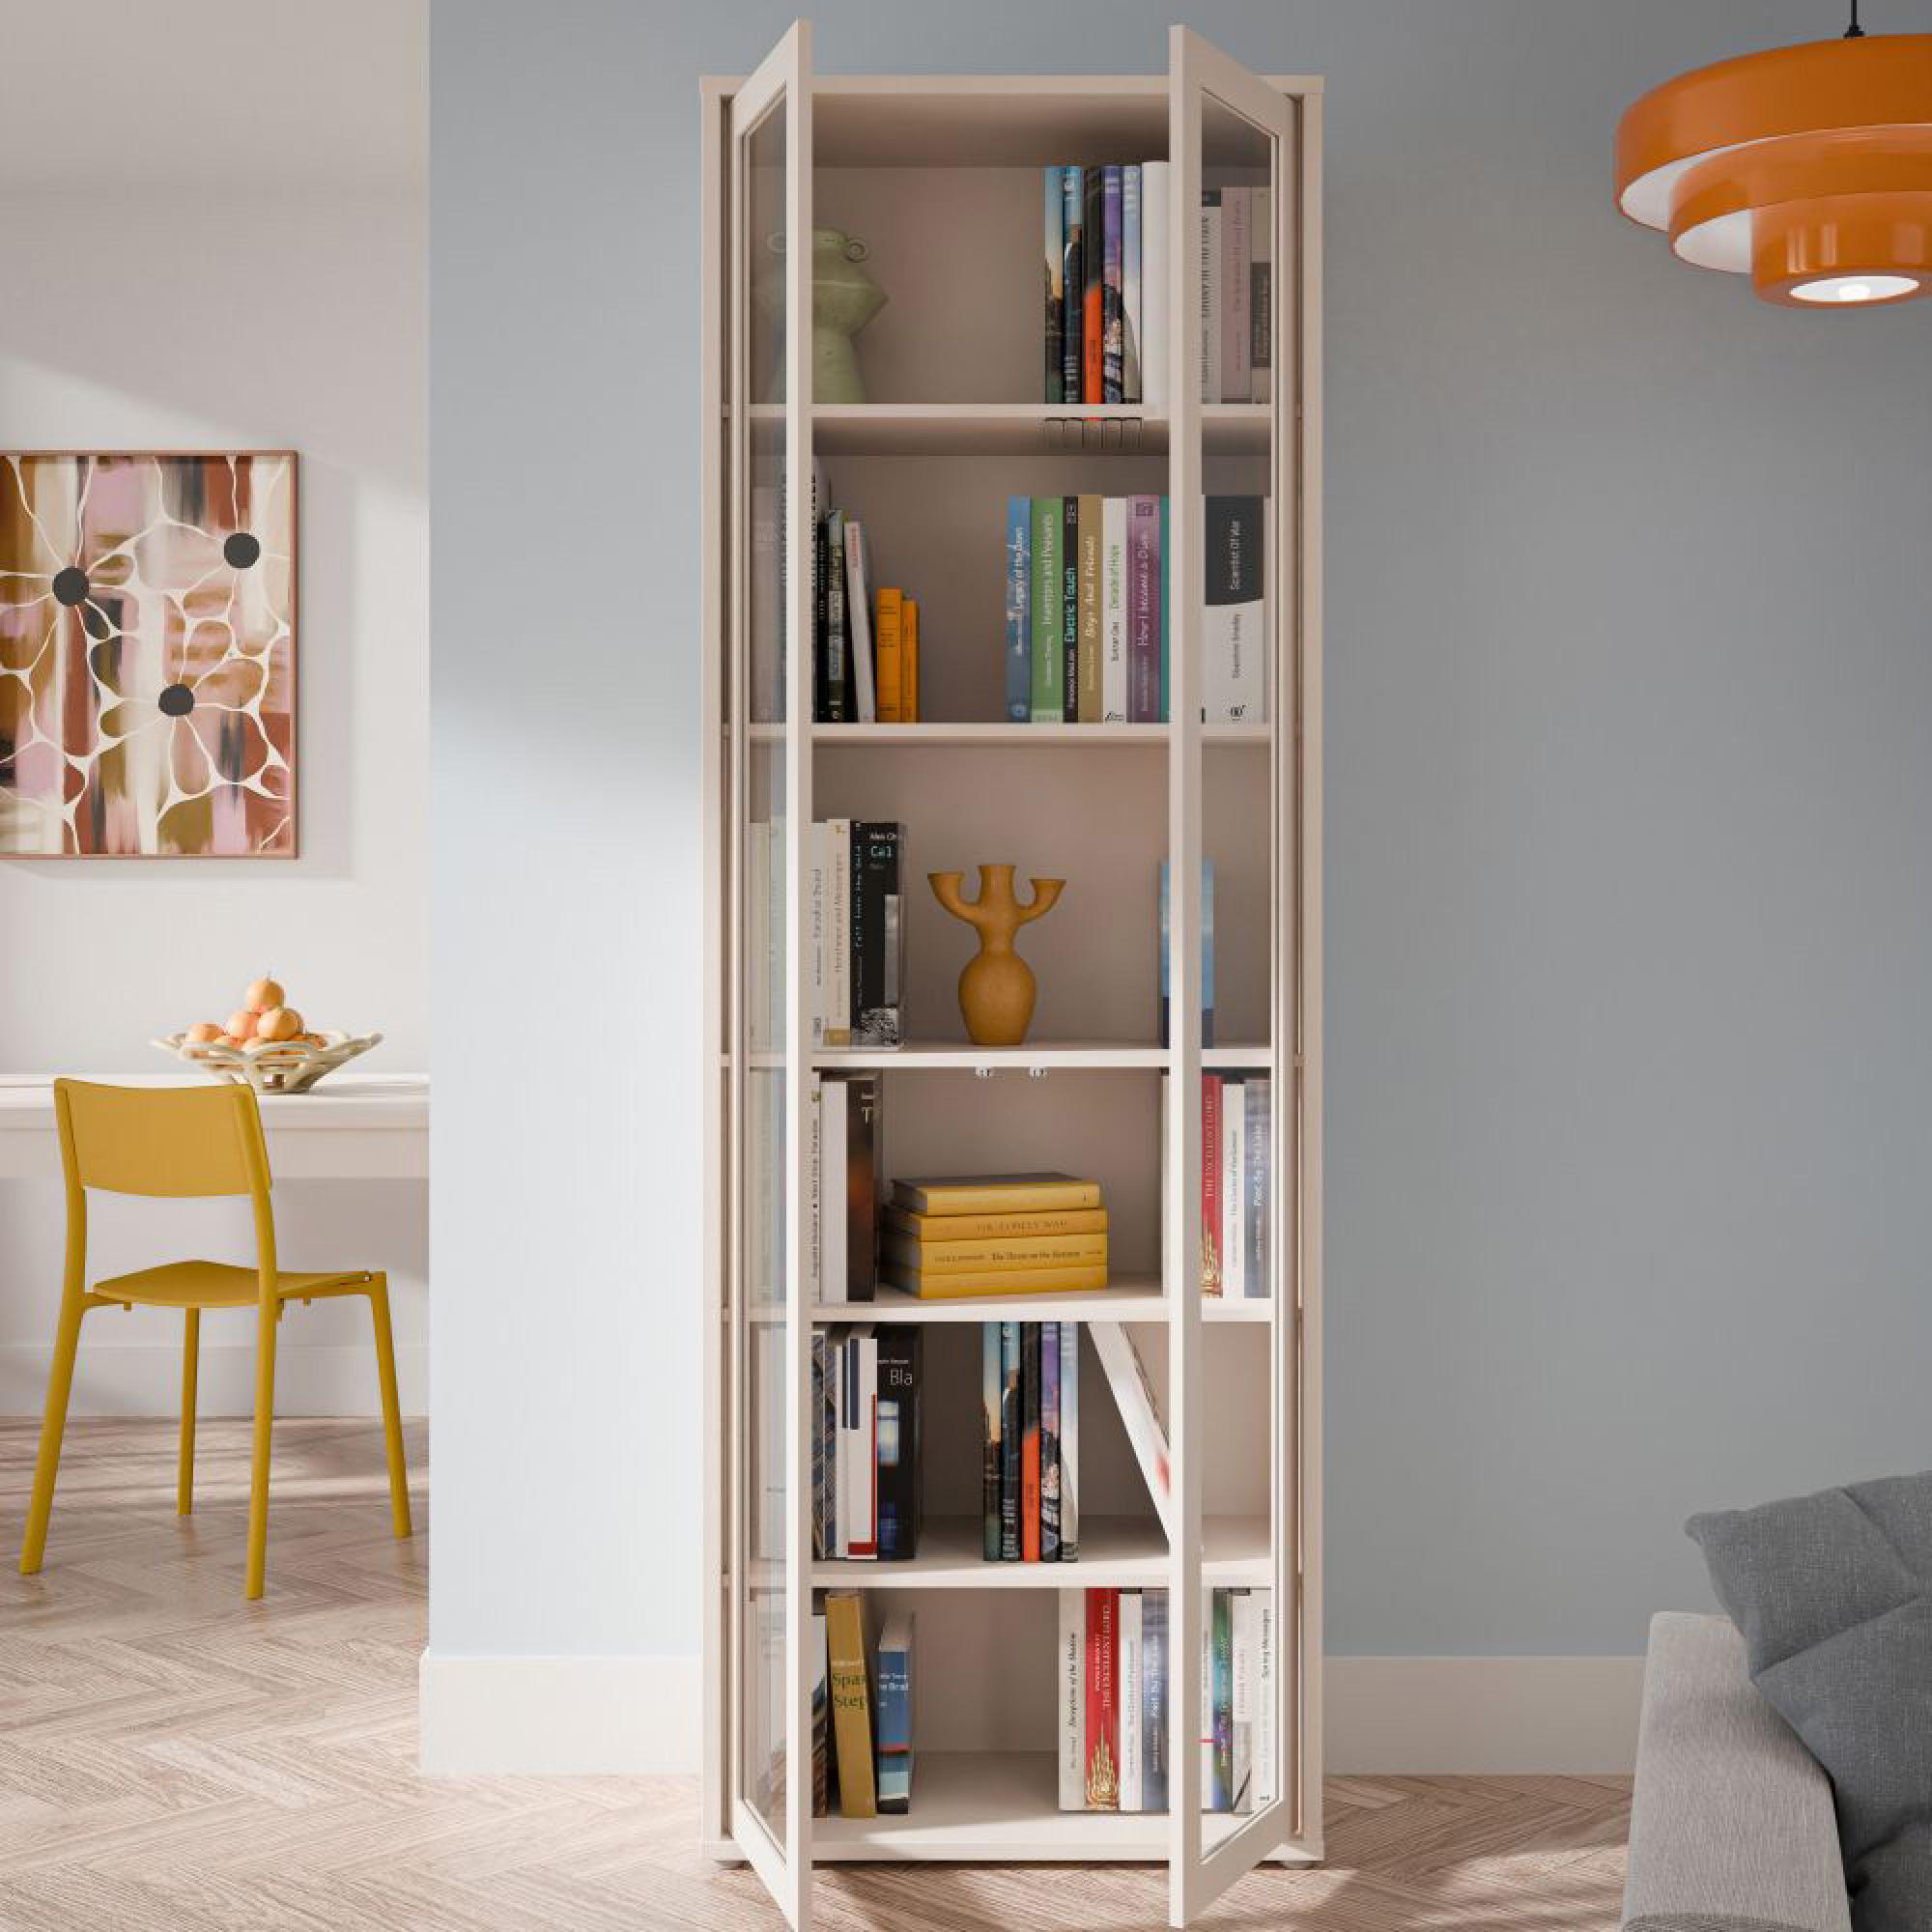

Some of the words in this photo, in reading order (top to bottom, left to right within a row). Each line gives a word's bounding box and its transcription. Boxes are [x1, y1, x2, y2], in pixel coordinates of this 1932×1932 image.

[1065, 568, 1076, 602] Touch
[1065, 605, 1076, 642] Electric
[890, 1367, 913, 1386] Bla
